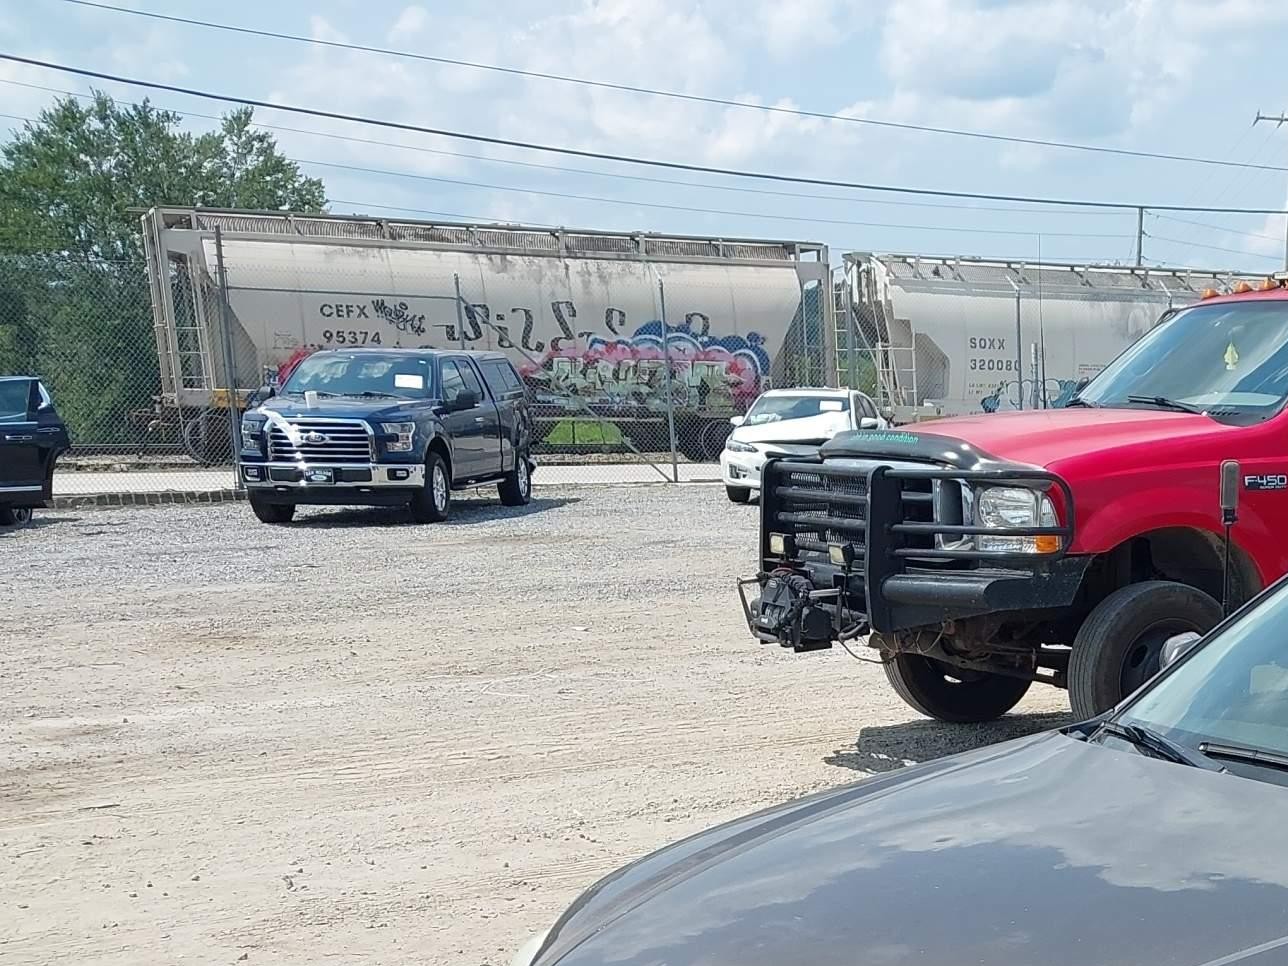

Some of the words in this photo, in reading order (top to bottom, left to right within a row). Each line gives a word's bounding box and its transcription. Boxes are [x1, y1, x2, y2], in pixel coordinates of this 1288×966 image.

[320, 303, 369, 319] CEFX
[323, 329, 382, 345] 95374
[969, 337, 1006, 350] SOXX
